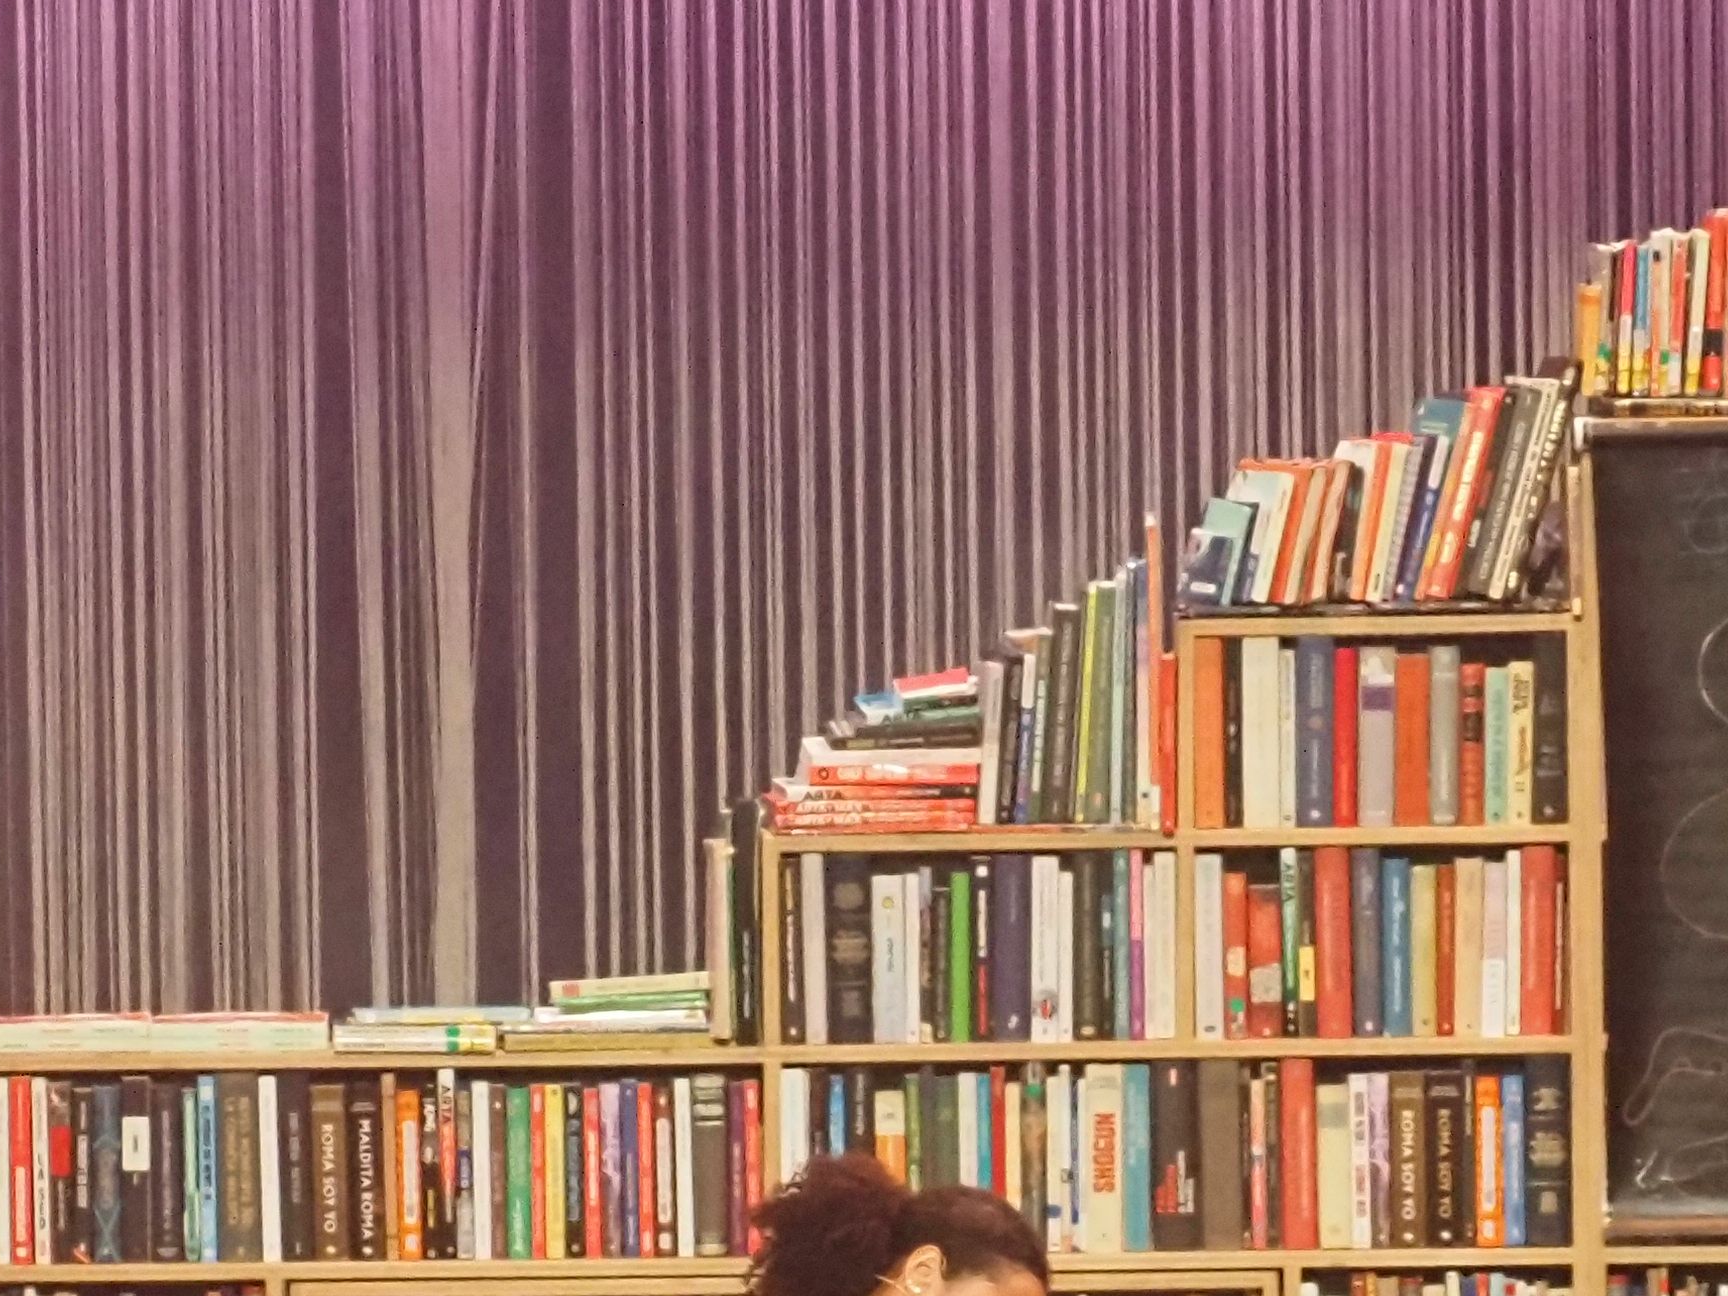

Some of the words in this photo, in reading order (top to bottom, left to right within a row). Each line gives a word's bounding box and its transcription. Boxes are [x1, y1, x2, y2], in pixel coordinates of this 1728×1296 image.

[320, 1123, 334, 1170] ROMA
[1401, 1109, 1415, 1157] ROMA
[1437, 1108, 1451, 1157] ROMA
[358, 1118, 372, 1187] MALDITA
[1092, 1112, 1116, 1194] SHOGUN
[322, 1176, 335, 1206] SOY
[1401, 1162, 1415, 1193] SOY
[1438, 1162, 1452, 1193] SOY
[324, 1212, 335, 1233] YO
[359, 1192, 374, 1240] ROMA
[1401, 1198, 1415, 1220] YO
[1438, 1197, 1452, 1218] YO
